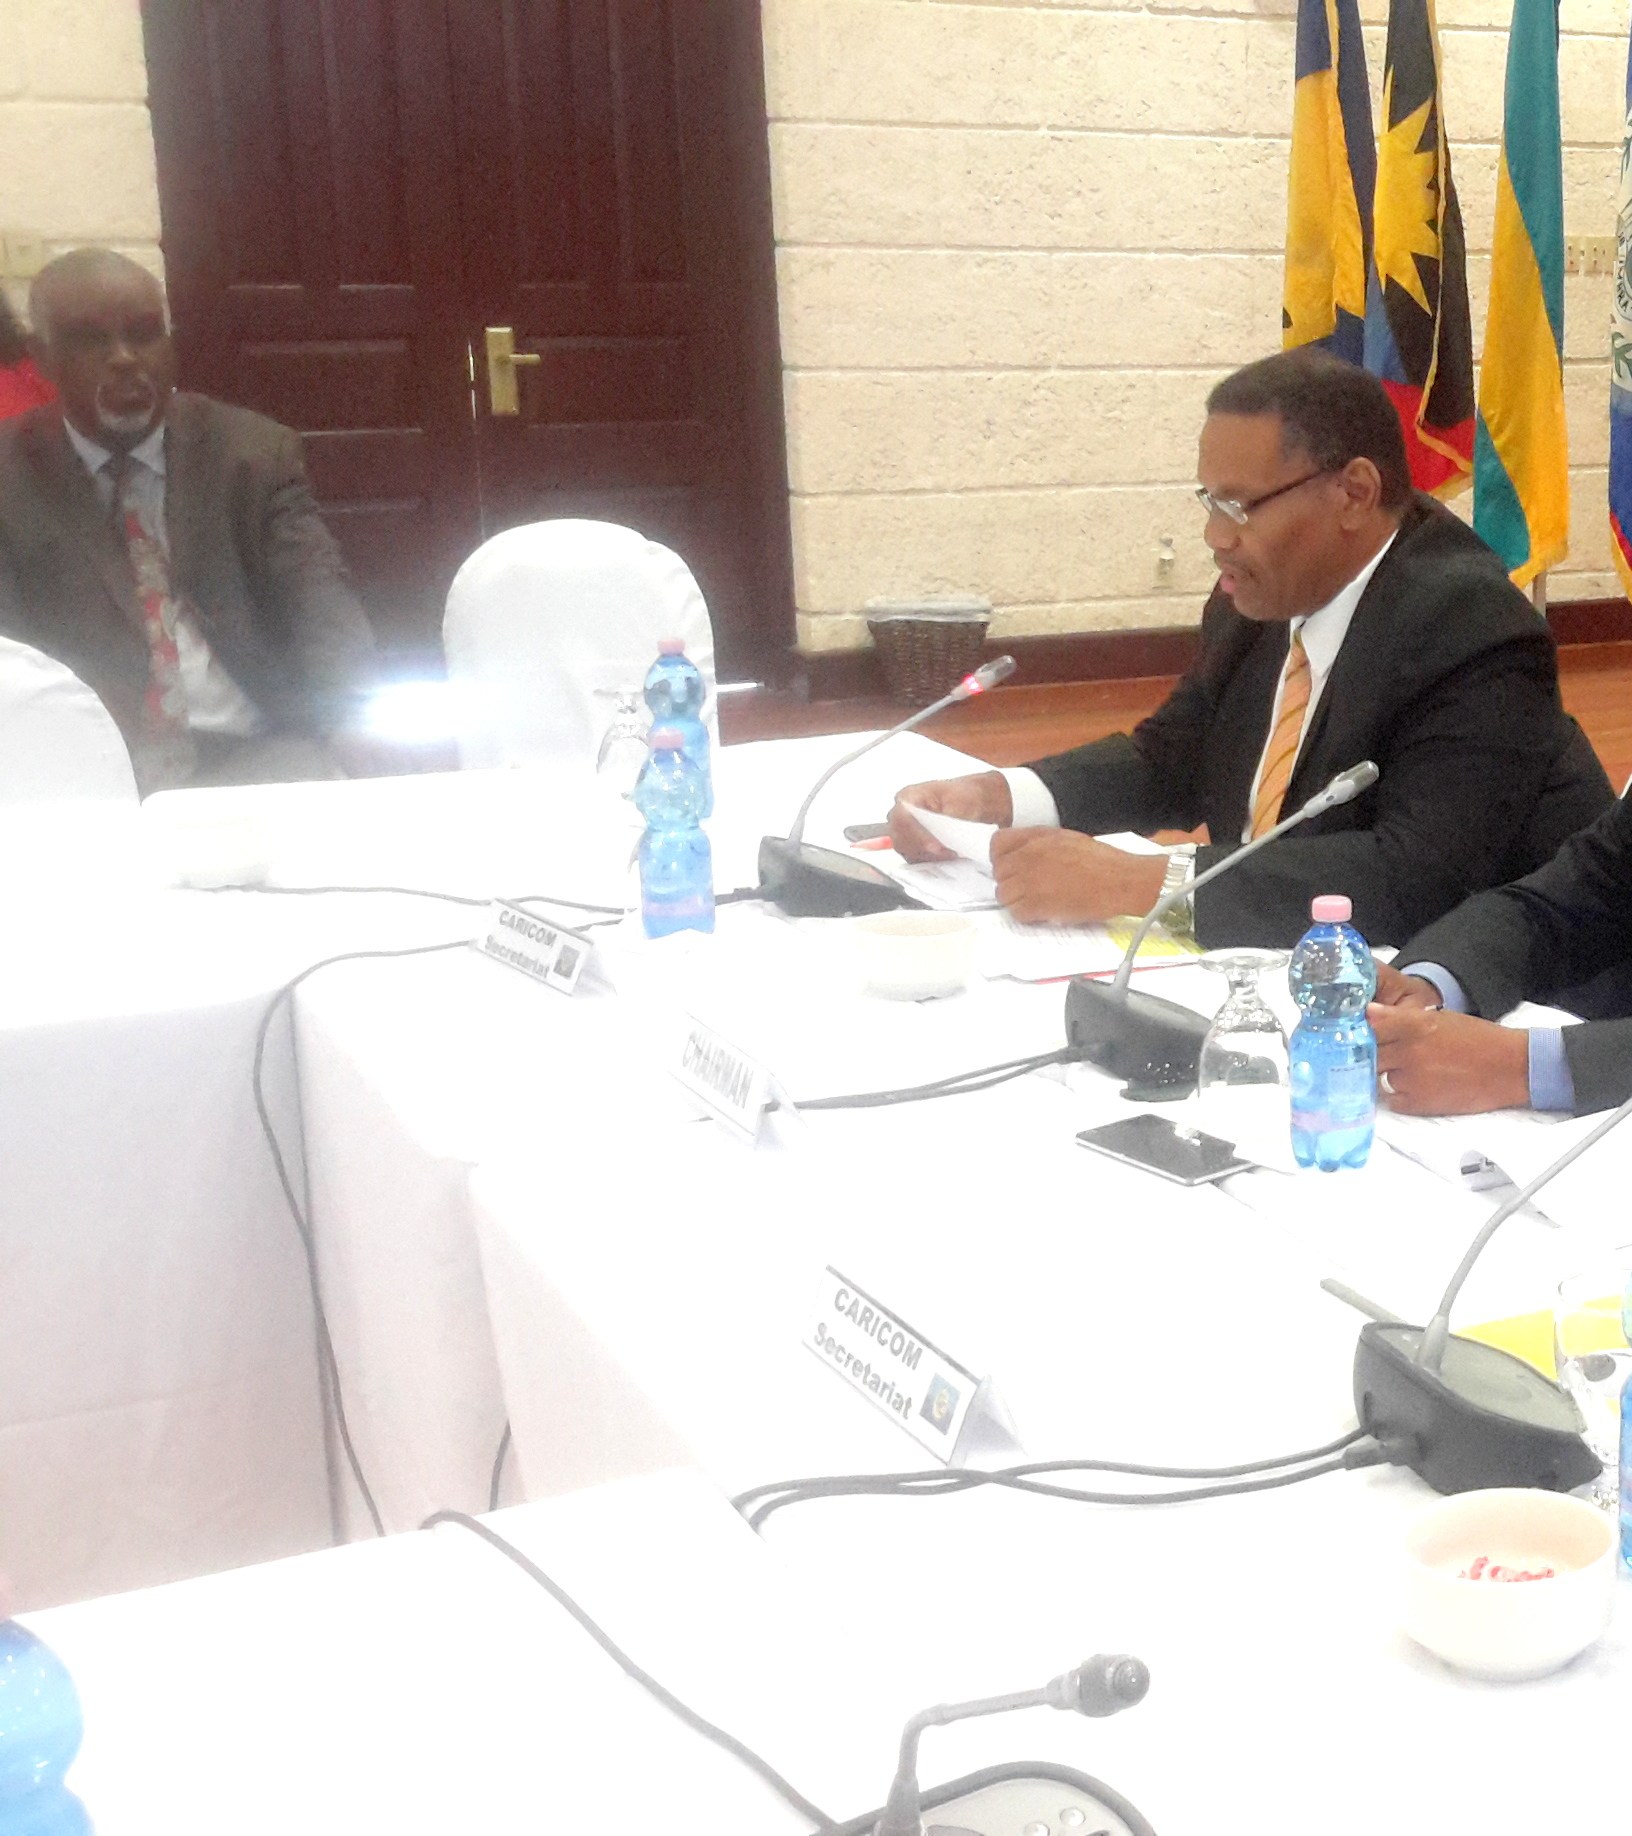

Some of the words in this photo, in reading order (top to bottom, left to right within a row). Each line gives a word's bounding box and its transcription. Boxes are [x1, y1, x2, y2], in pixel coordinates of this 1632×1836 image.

[485, 934, 550, 978] Secretariat
[499, 910, 557, 948] CARICOM
[683, 1031, 754, 1109] CHAIRMAN
[834, 1287, 924, 1371] CARICOM
[813, 1321, 913, 1421] Secretariat
